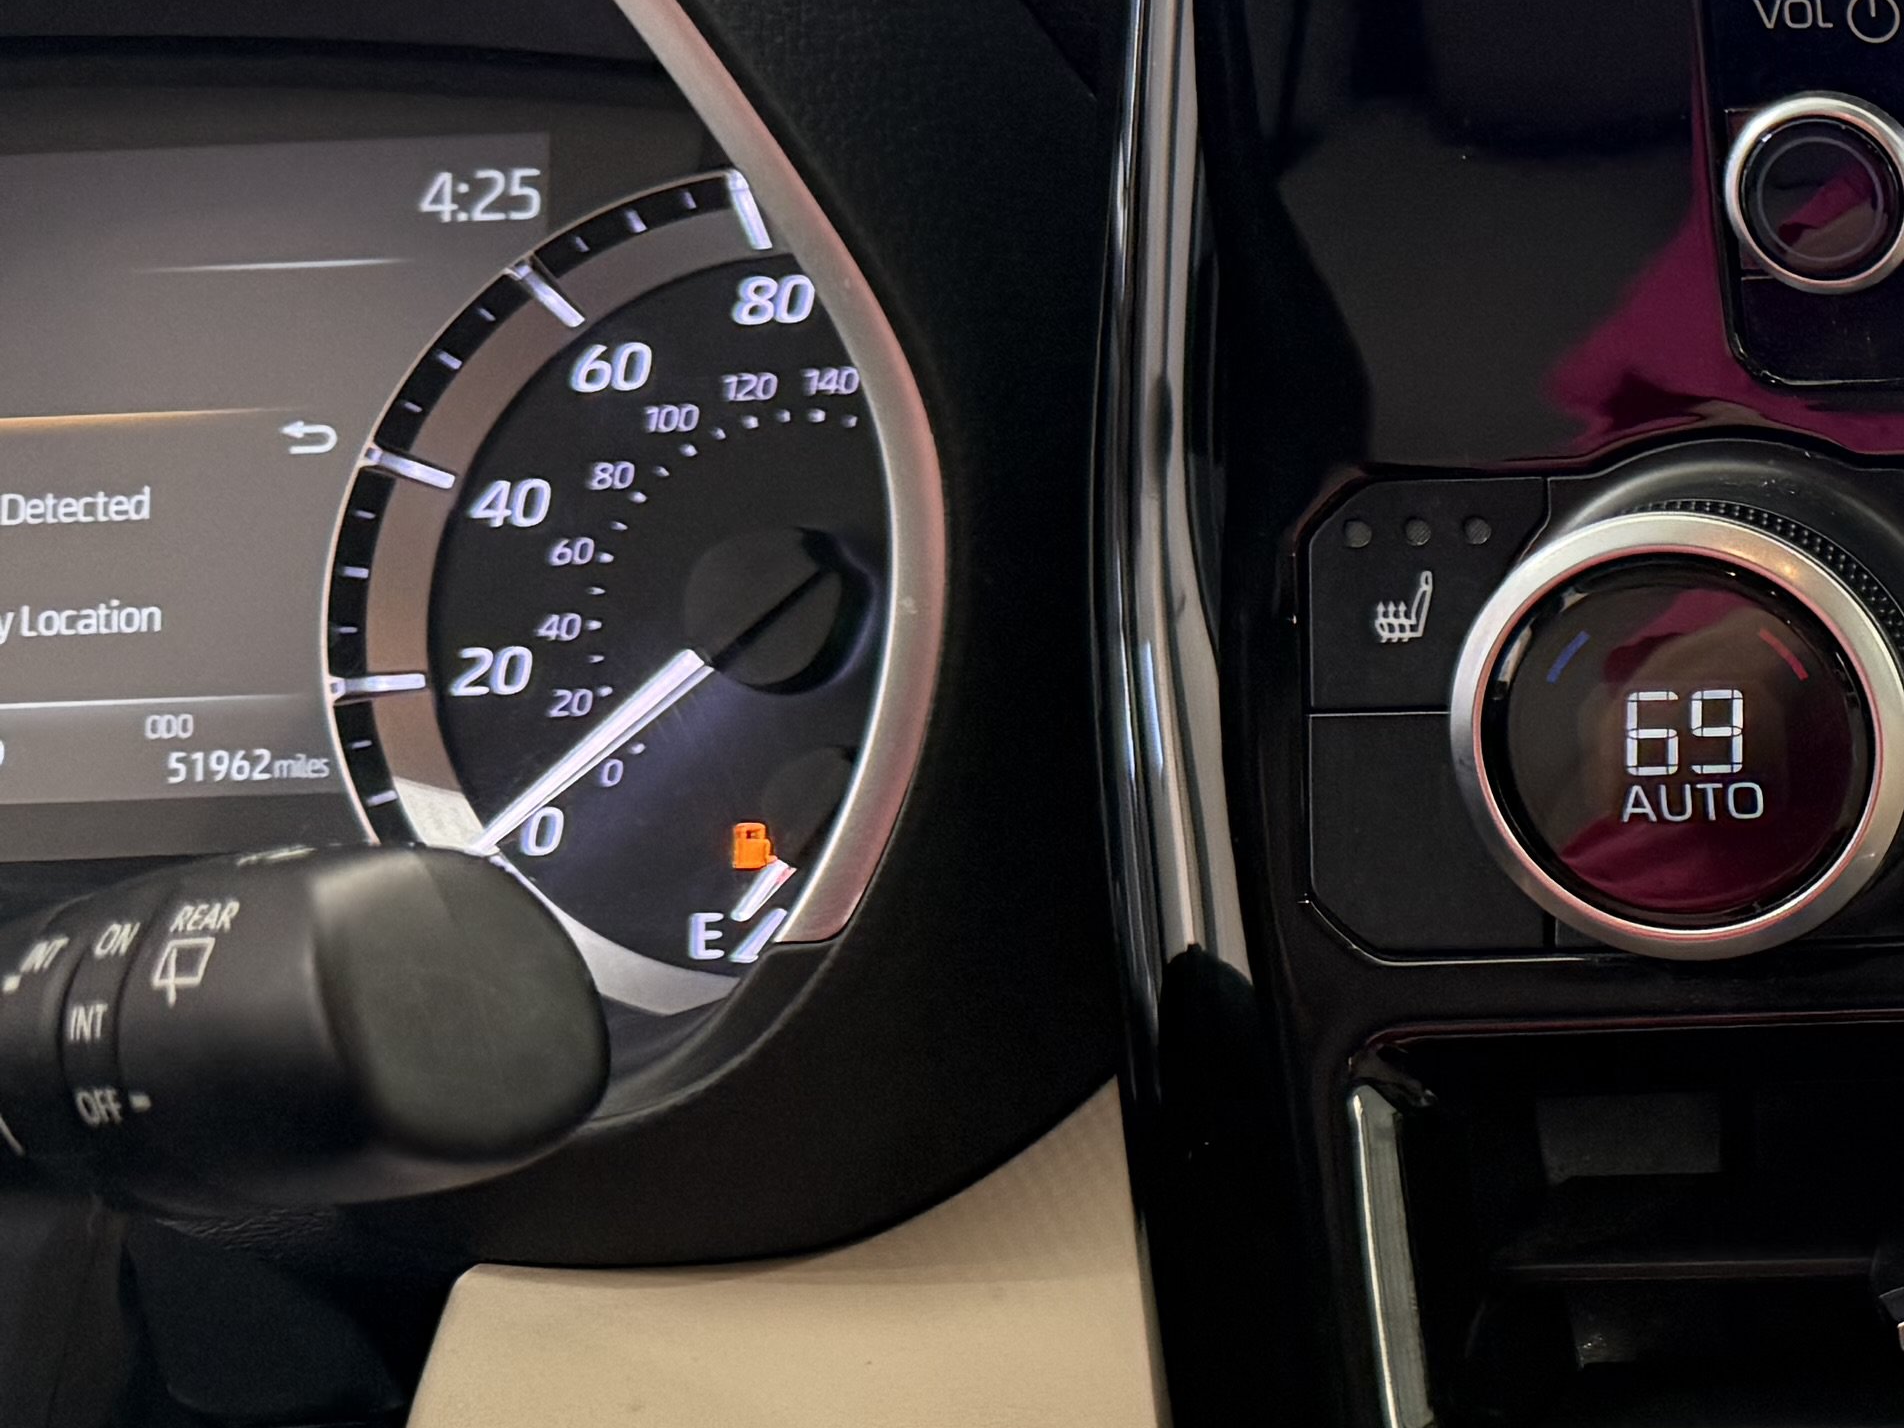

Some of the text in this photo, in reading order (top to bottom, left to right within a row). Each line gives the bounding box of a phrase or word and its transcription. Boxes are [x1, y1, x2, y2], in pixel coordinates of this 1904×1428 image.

[419, 167, 542, 223] 4:25
[731, 274, 815, 326] 80
[571, 341, 653, 393] 60
[722, 371, 778, 401] 120
[803, 366, 859, 396] 140
[644, 403, 700, 434] 100
[586, 461, 635, 491] 80
[0, 485, 151, 526] Detected
[467, 478, 552, 528] 40
[548, 537, 595, 567] 60
[20, 600, 162, 638] Location
[533, 613, 582, 642] 40
[451, 646, 533, 697] 20
[546, 688, 594, 719] 20
[1624, 686, 1745, 777] 69
[167, 748, 272, 785] 51962
[600, 758, 624, 788] 0
[1621, 781, 1764, 824] AUTO
[519, 806, 564, 857] 0
[170, 898, 241, 933] REAR
[94, 922, 141, 959] ON
[688, 912, 725, 960] E
[67, 1003, 108, 1044] INT
[75, 1086, 123, 1126] OFF
